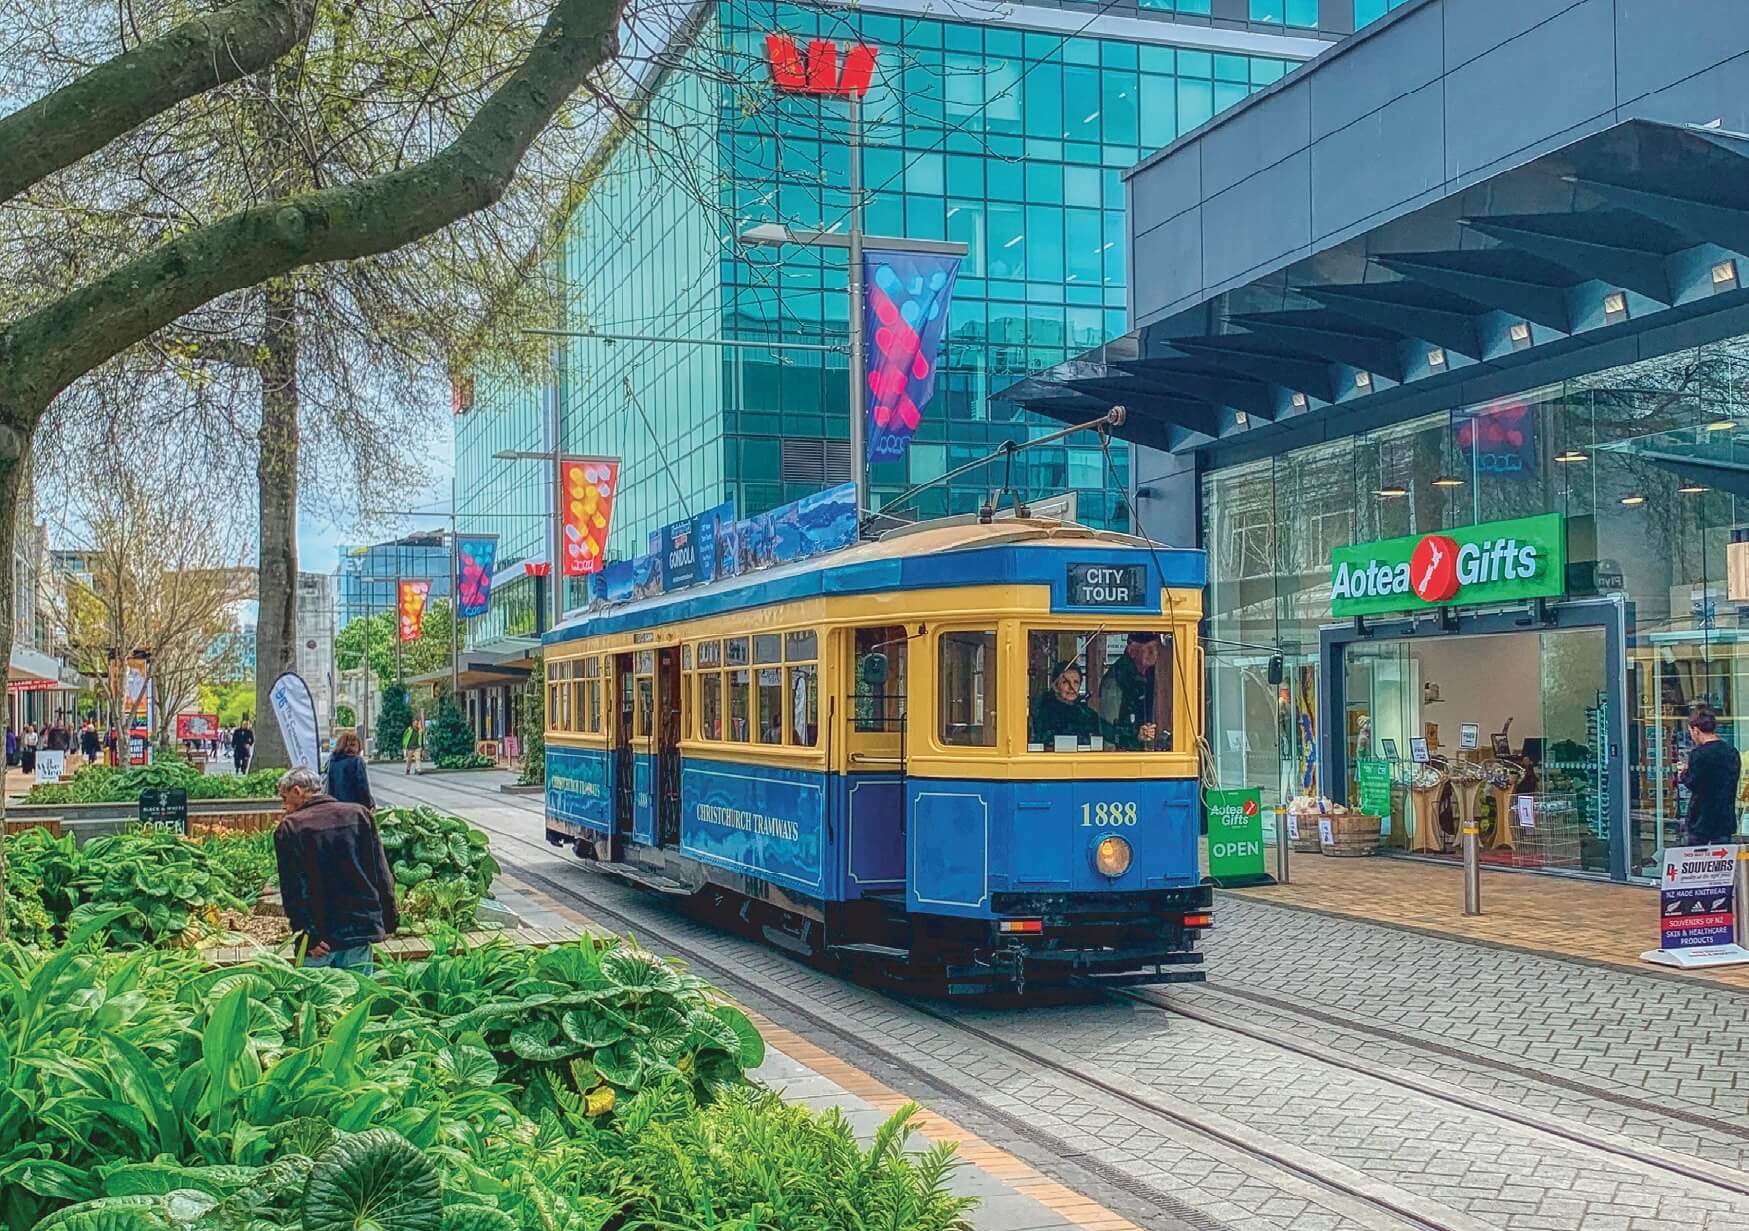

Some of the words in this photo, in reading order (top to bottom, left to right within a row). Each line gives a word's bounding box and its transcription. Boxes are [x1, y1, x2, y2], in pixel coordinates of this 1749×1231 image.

[669, 545, 695, 569] GONDOLA
[1086, 568, 1124, 584] CITY
[1330, 560, 1410, 599] Aotea
[1456, 539, 1536, 586] Gifts
[1082, 587, 1129, 601] TOUR
[1080, 801, 1137, 827] 1888
[1210, 805, 1243, 816] Aotea
[696, 803, 752, 831] CHRISTCHURCH
[752, 814, 799, 841] TRAMWAYS
[1221, 815, 1249, 826] Gifts
[1213, 841, 1259, 857] OPEN
[1681, 859, 1733, 873] SOUVENIRS
[1676, 889, 1693, 897] MADE
[1694, 887, 1727, 896] KNITWEAR
[1669, 918, 1704, 927] SOUVENIRS
[1665, 930, 1681, 938] SKIN
[1689, 926, 1728, 936] HEALTHCARE
[1680, 936, 1714, 945] PRODUCTS
